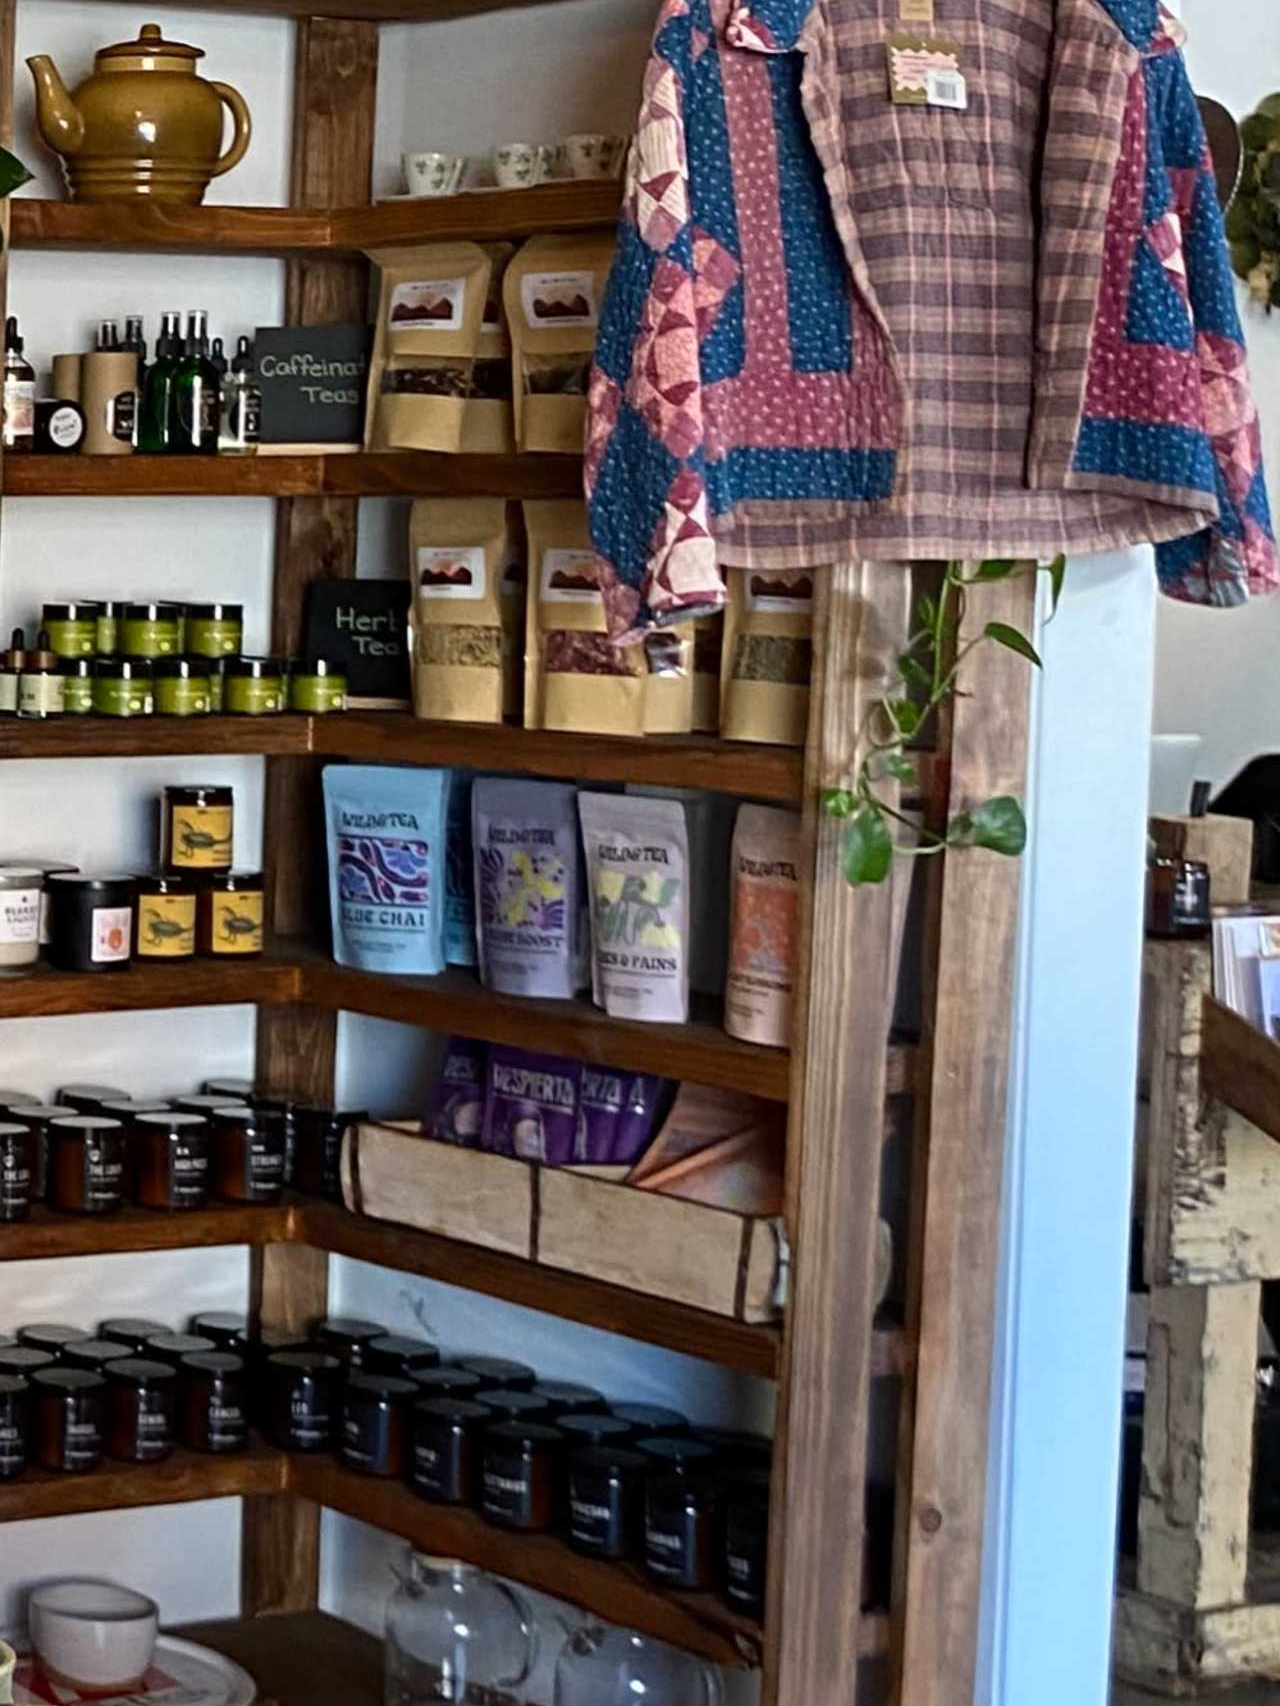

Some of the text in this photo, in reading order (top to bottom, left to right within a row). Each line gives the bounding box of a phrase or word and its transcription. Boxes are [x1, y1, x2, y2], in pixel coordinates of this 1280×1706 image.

[300, 386, 359, 404] Teas
[379, 911, 425, 927] CHAI
[631, 955, 677, 972] PAINS
[493, 1062, 574, 1105] DESPIERTA
